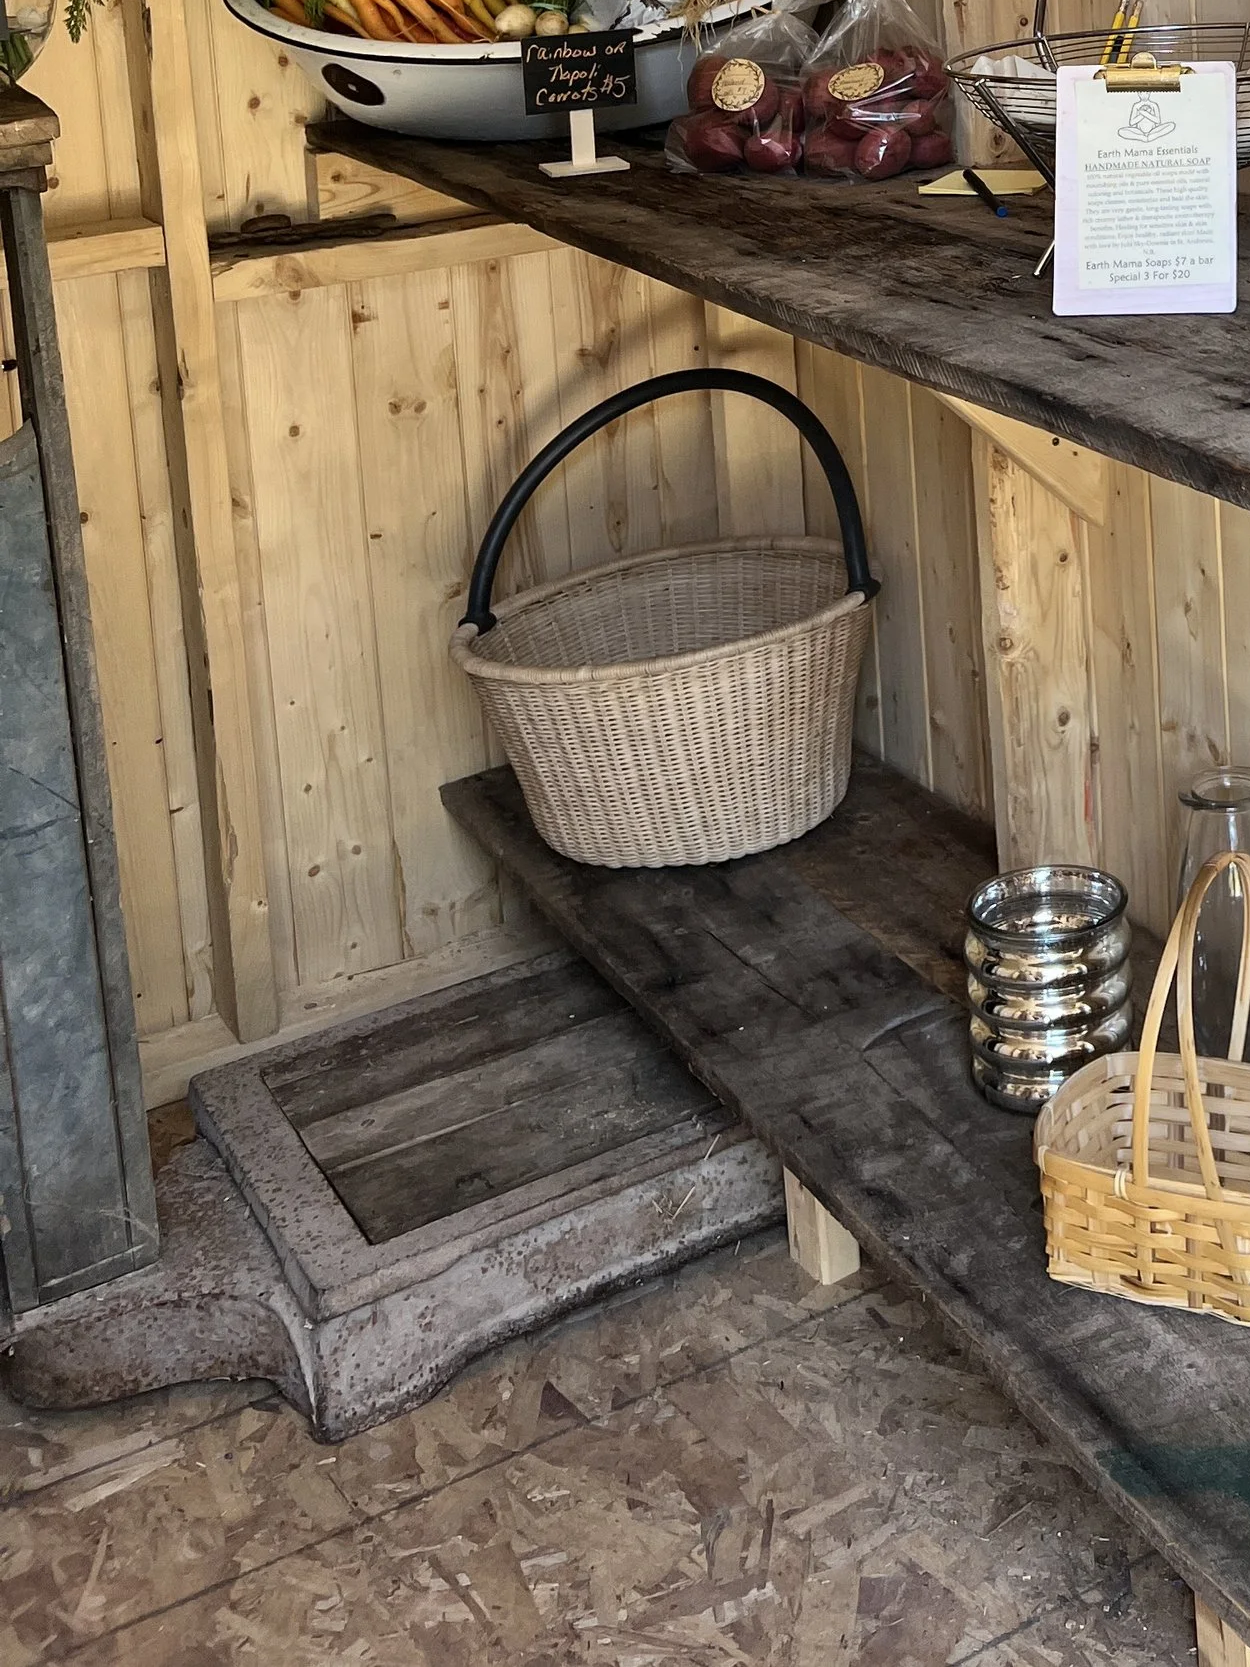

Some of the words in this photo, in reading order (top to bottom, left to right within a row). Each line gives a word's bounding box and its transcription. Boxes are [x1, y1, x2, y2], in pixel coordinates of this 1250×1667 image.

[1097, 149, 1121, 159] Earth
[1124, 148, 1154, 158] Mama
[1156, 145, 1198, 156] Essentials
[1085, 161, 1140, 171] HANDMADE
[1141, 159, 1184, 169] NATURAL
[1186, 157, 1211, 166] SOAP
[1086, 261, 1110, 270] Earth
[1113, 260, 1143, 269] Mama
[1145, 258, 1172, 268] Soaps
[1175, 255, 1187, 267] $7
[1198, 256, 1214, 265] bar
[1109, 272, 1141, 284] Special
[1144, 272, 1150, 281] 3
[1153, 271, 1169, 280] For
[1172, 269, 1191, 280] $20
